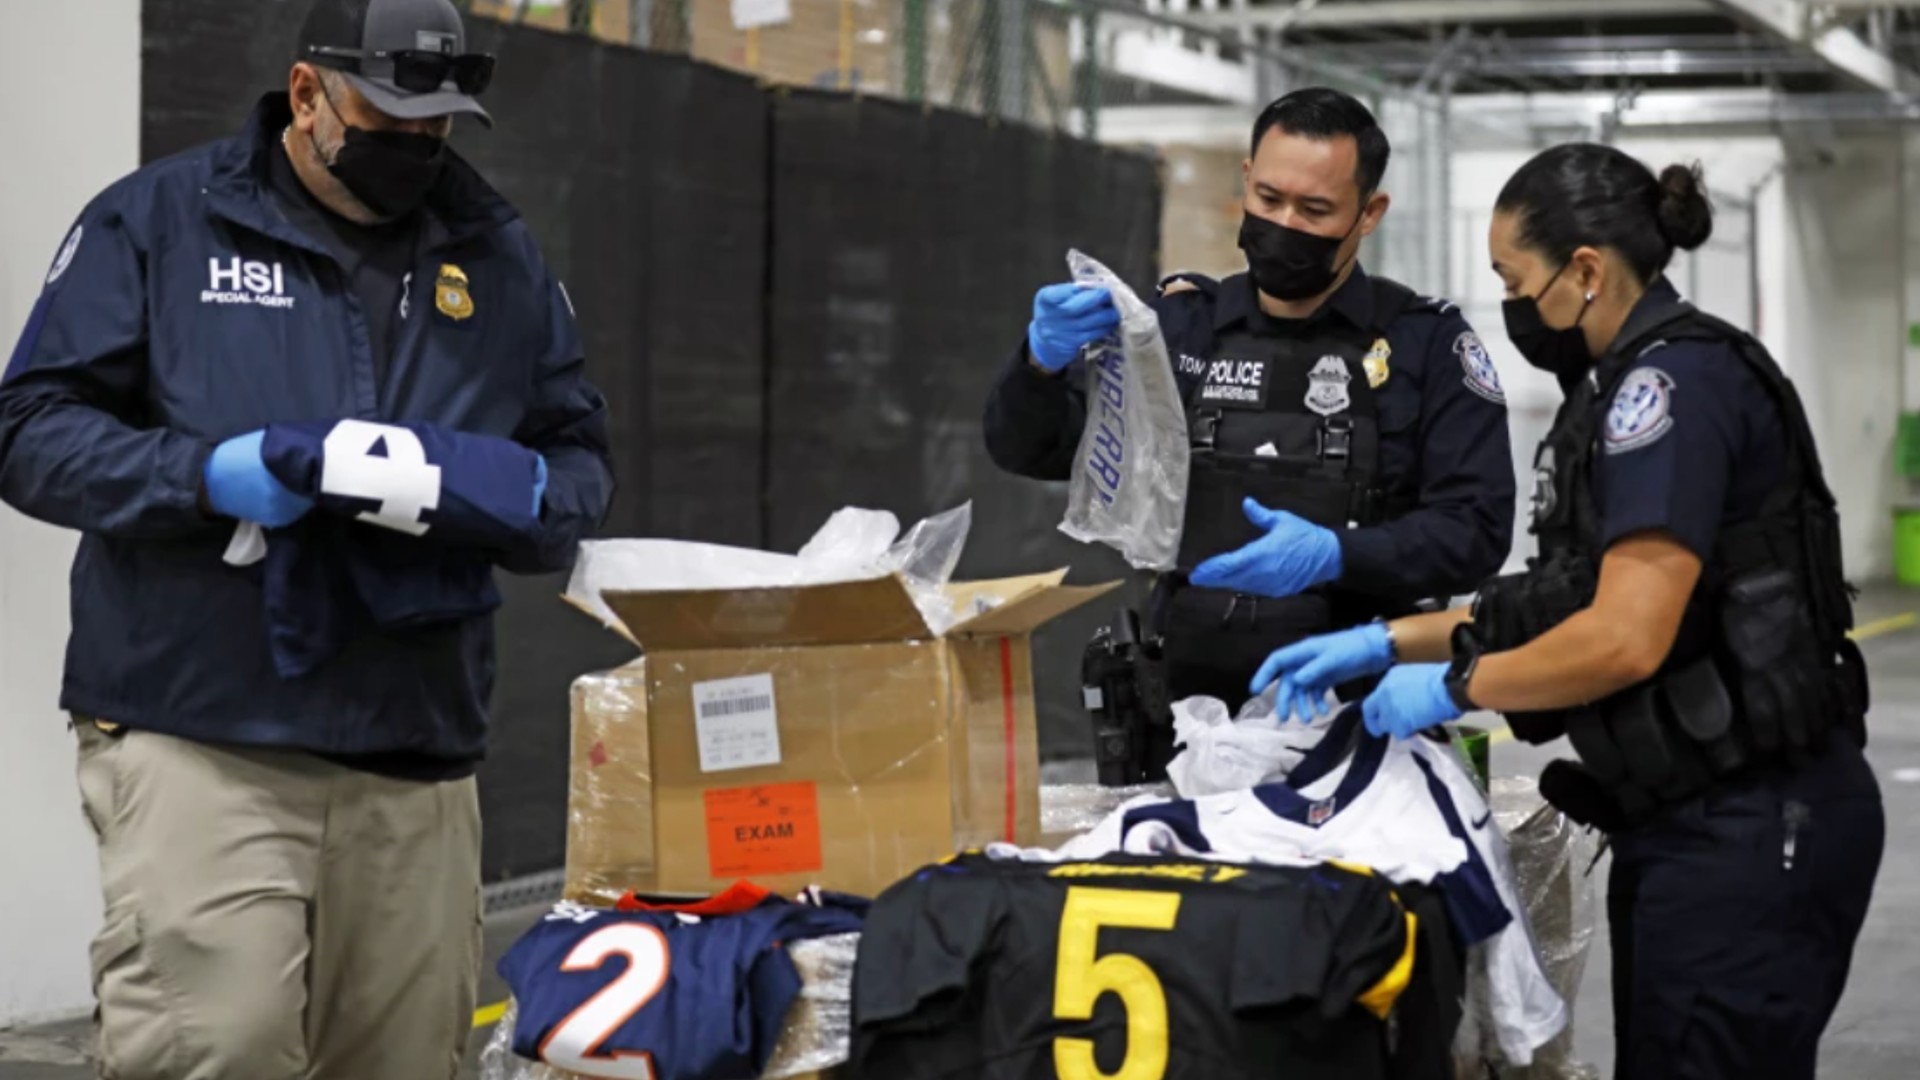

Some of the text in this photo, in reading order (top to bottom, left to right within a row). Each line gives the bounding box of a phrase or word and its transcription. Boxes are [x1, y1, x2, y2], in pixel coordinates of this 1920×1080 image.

[209, 256, 284, 295] HSI
[201, 289, 252, 303] SPECIAL
[1206, 360, 1264, 386] POLICE
[734, 822, 794, 842] EXAM
[1053, 886, 1182, 1080] 5
[537, 920, 670, 1080] 2
